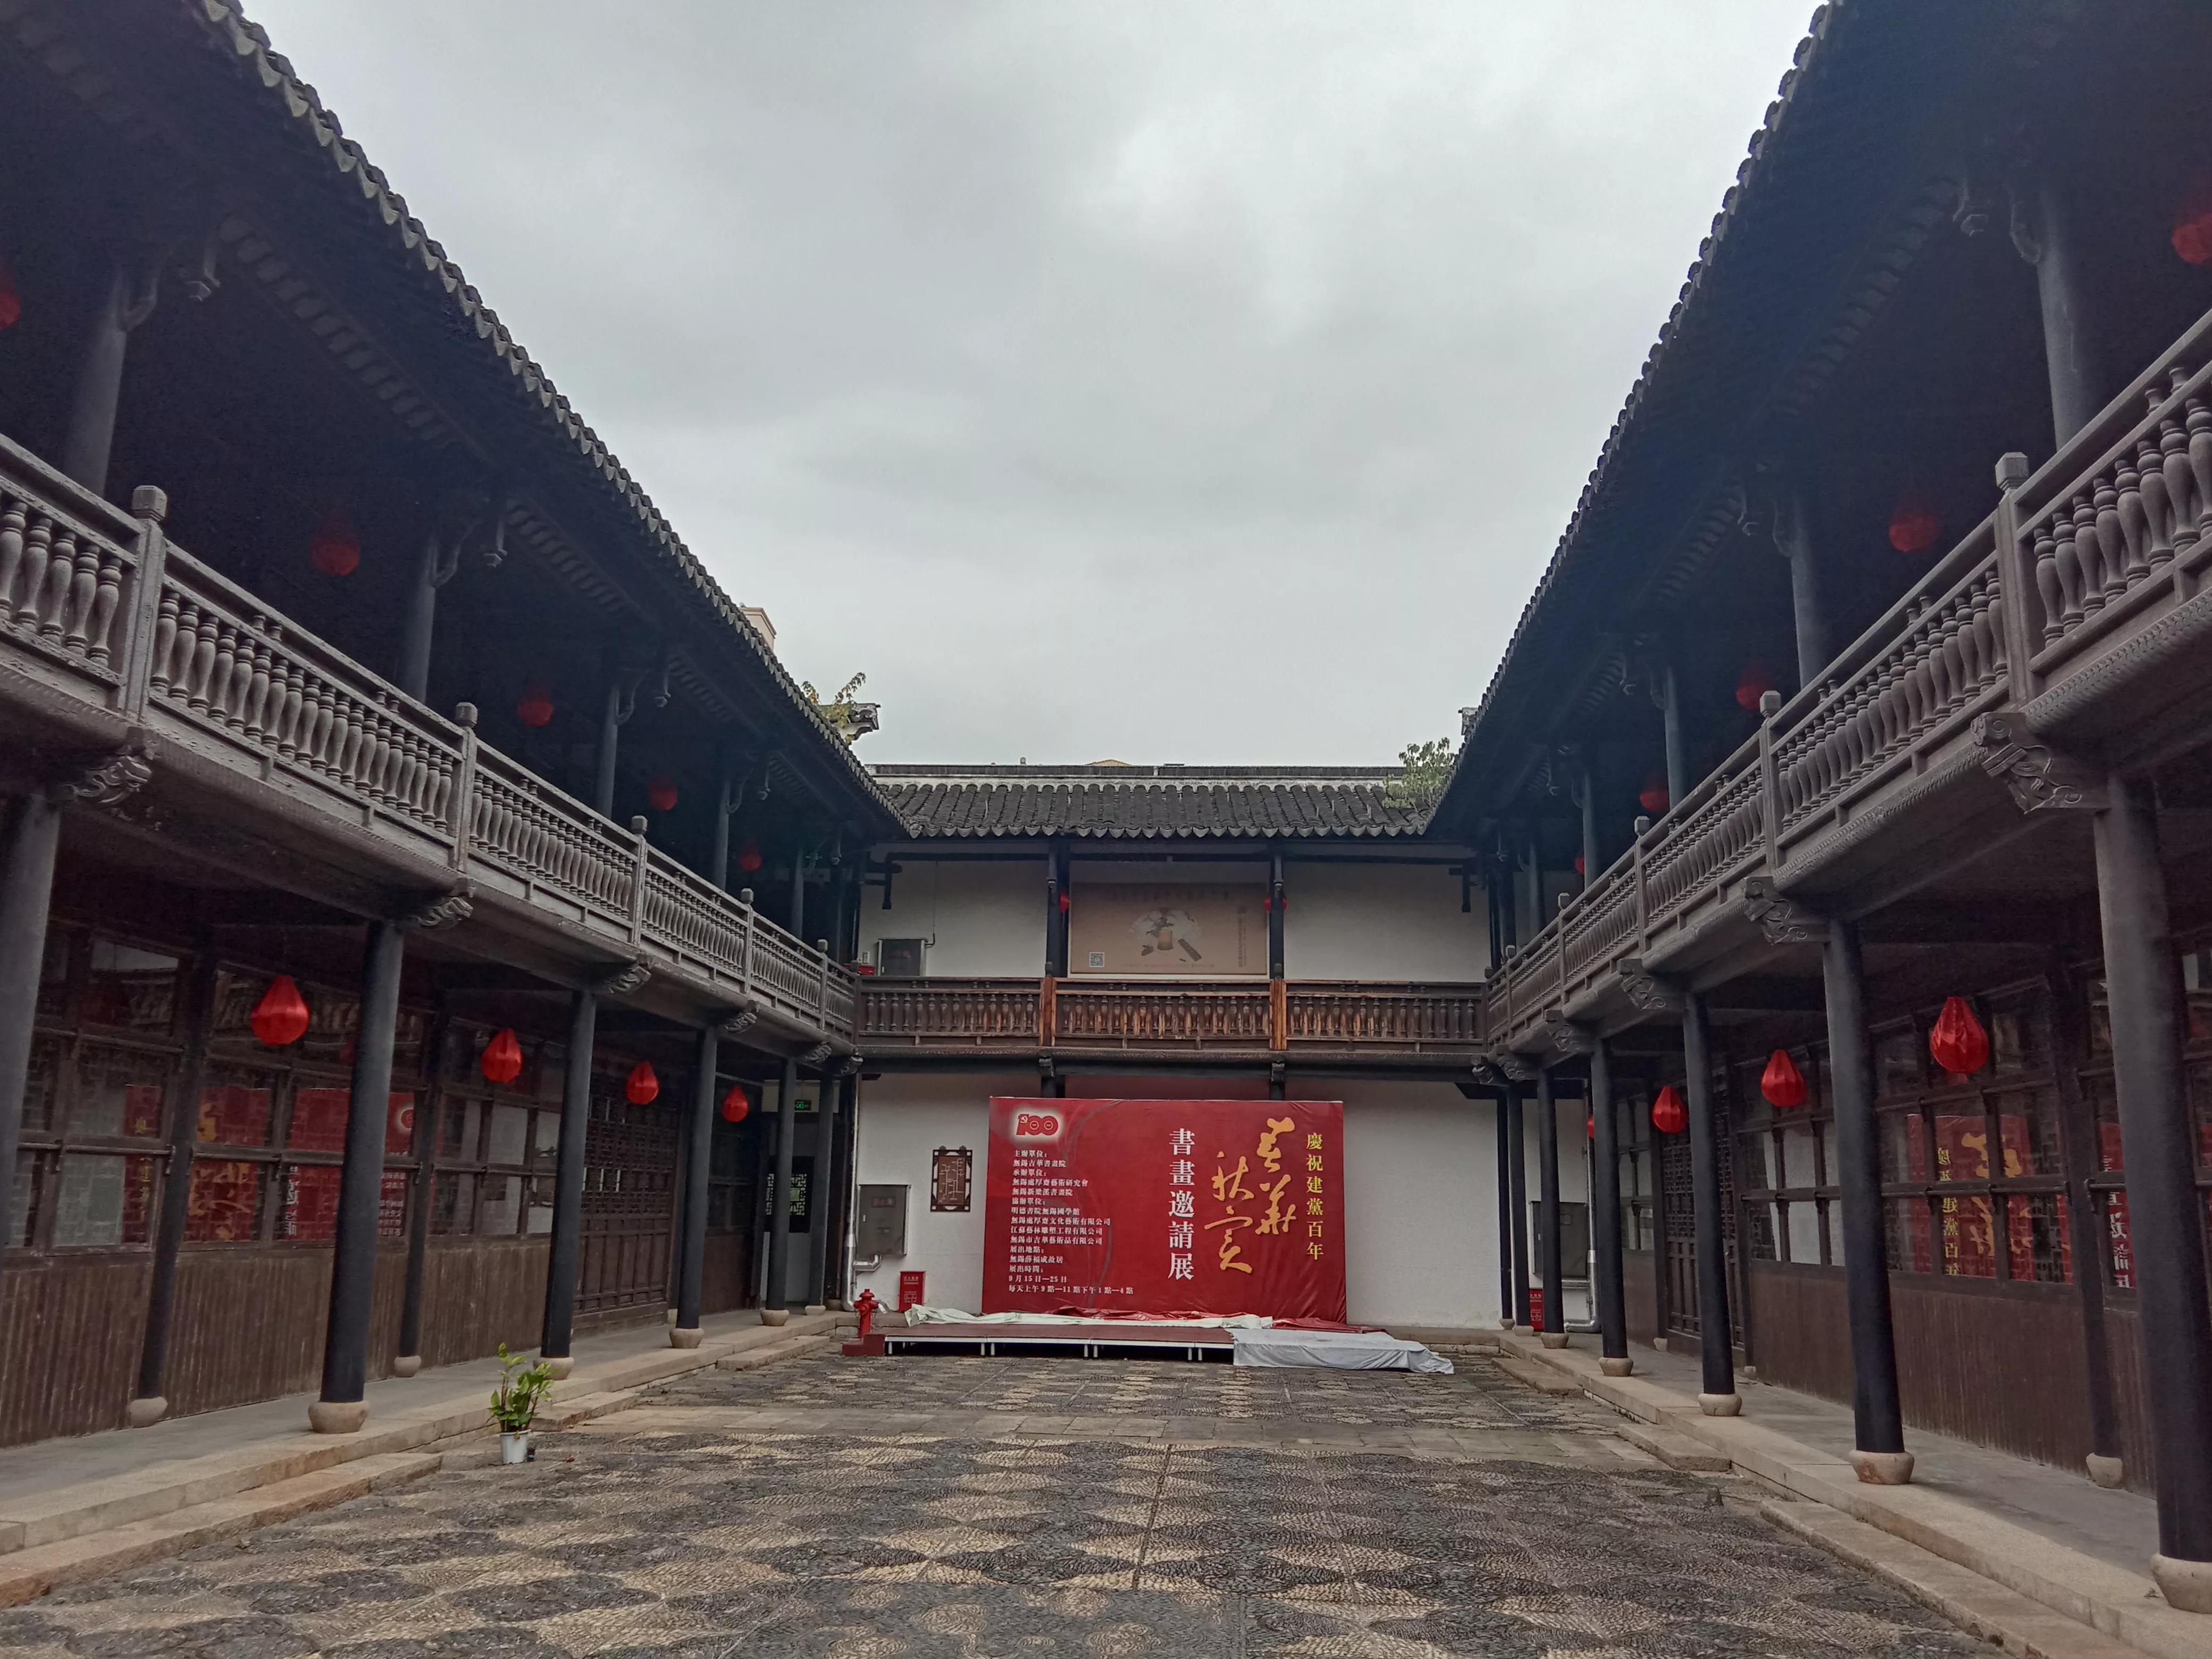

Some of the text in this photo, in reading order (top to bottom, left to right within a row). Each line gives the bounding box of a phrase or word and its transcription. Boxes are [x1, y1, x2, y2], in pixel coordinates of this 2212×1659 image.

[1016, 1113, 1059, 1136] 100
[1168, 1128, 1195, 1280] 書畫邀請展
[1306, 1132, 1324, 1260] 慶祝建黨百年
